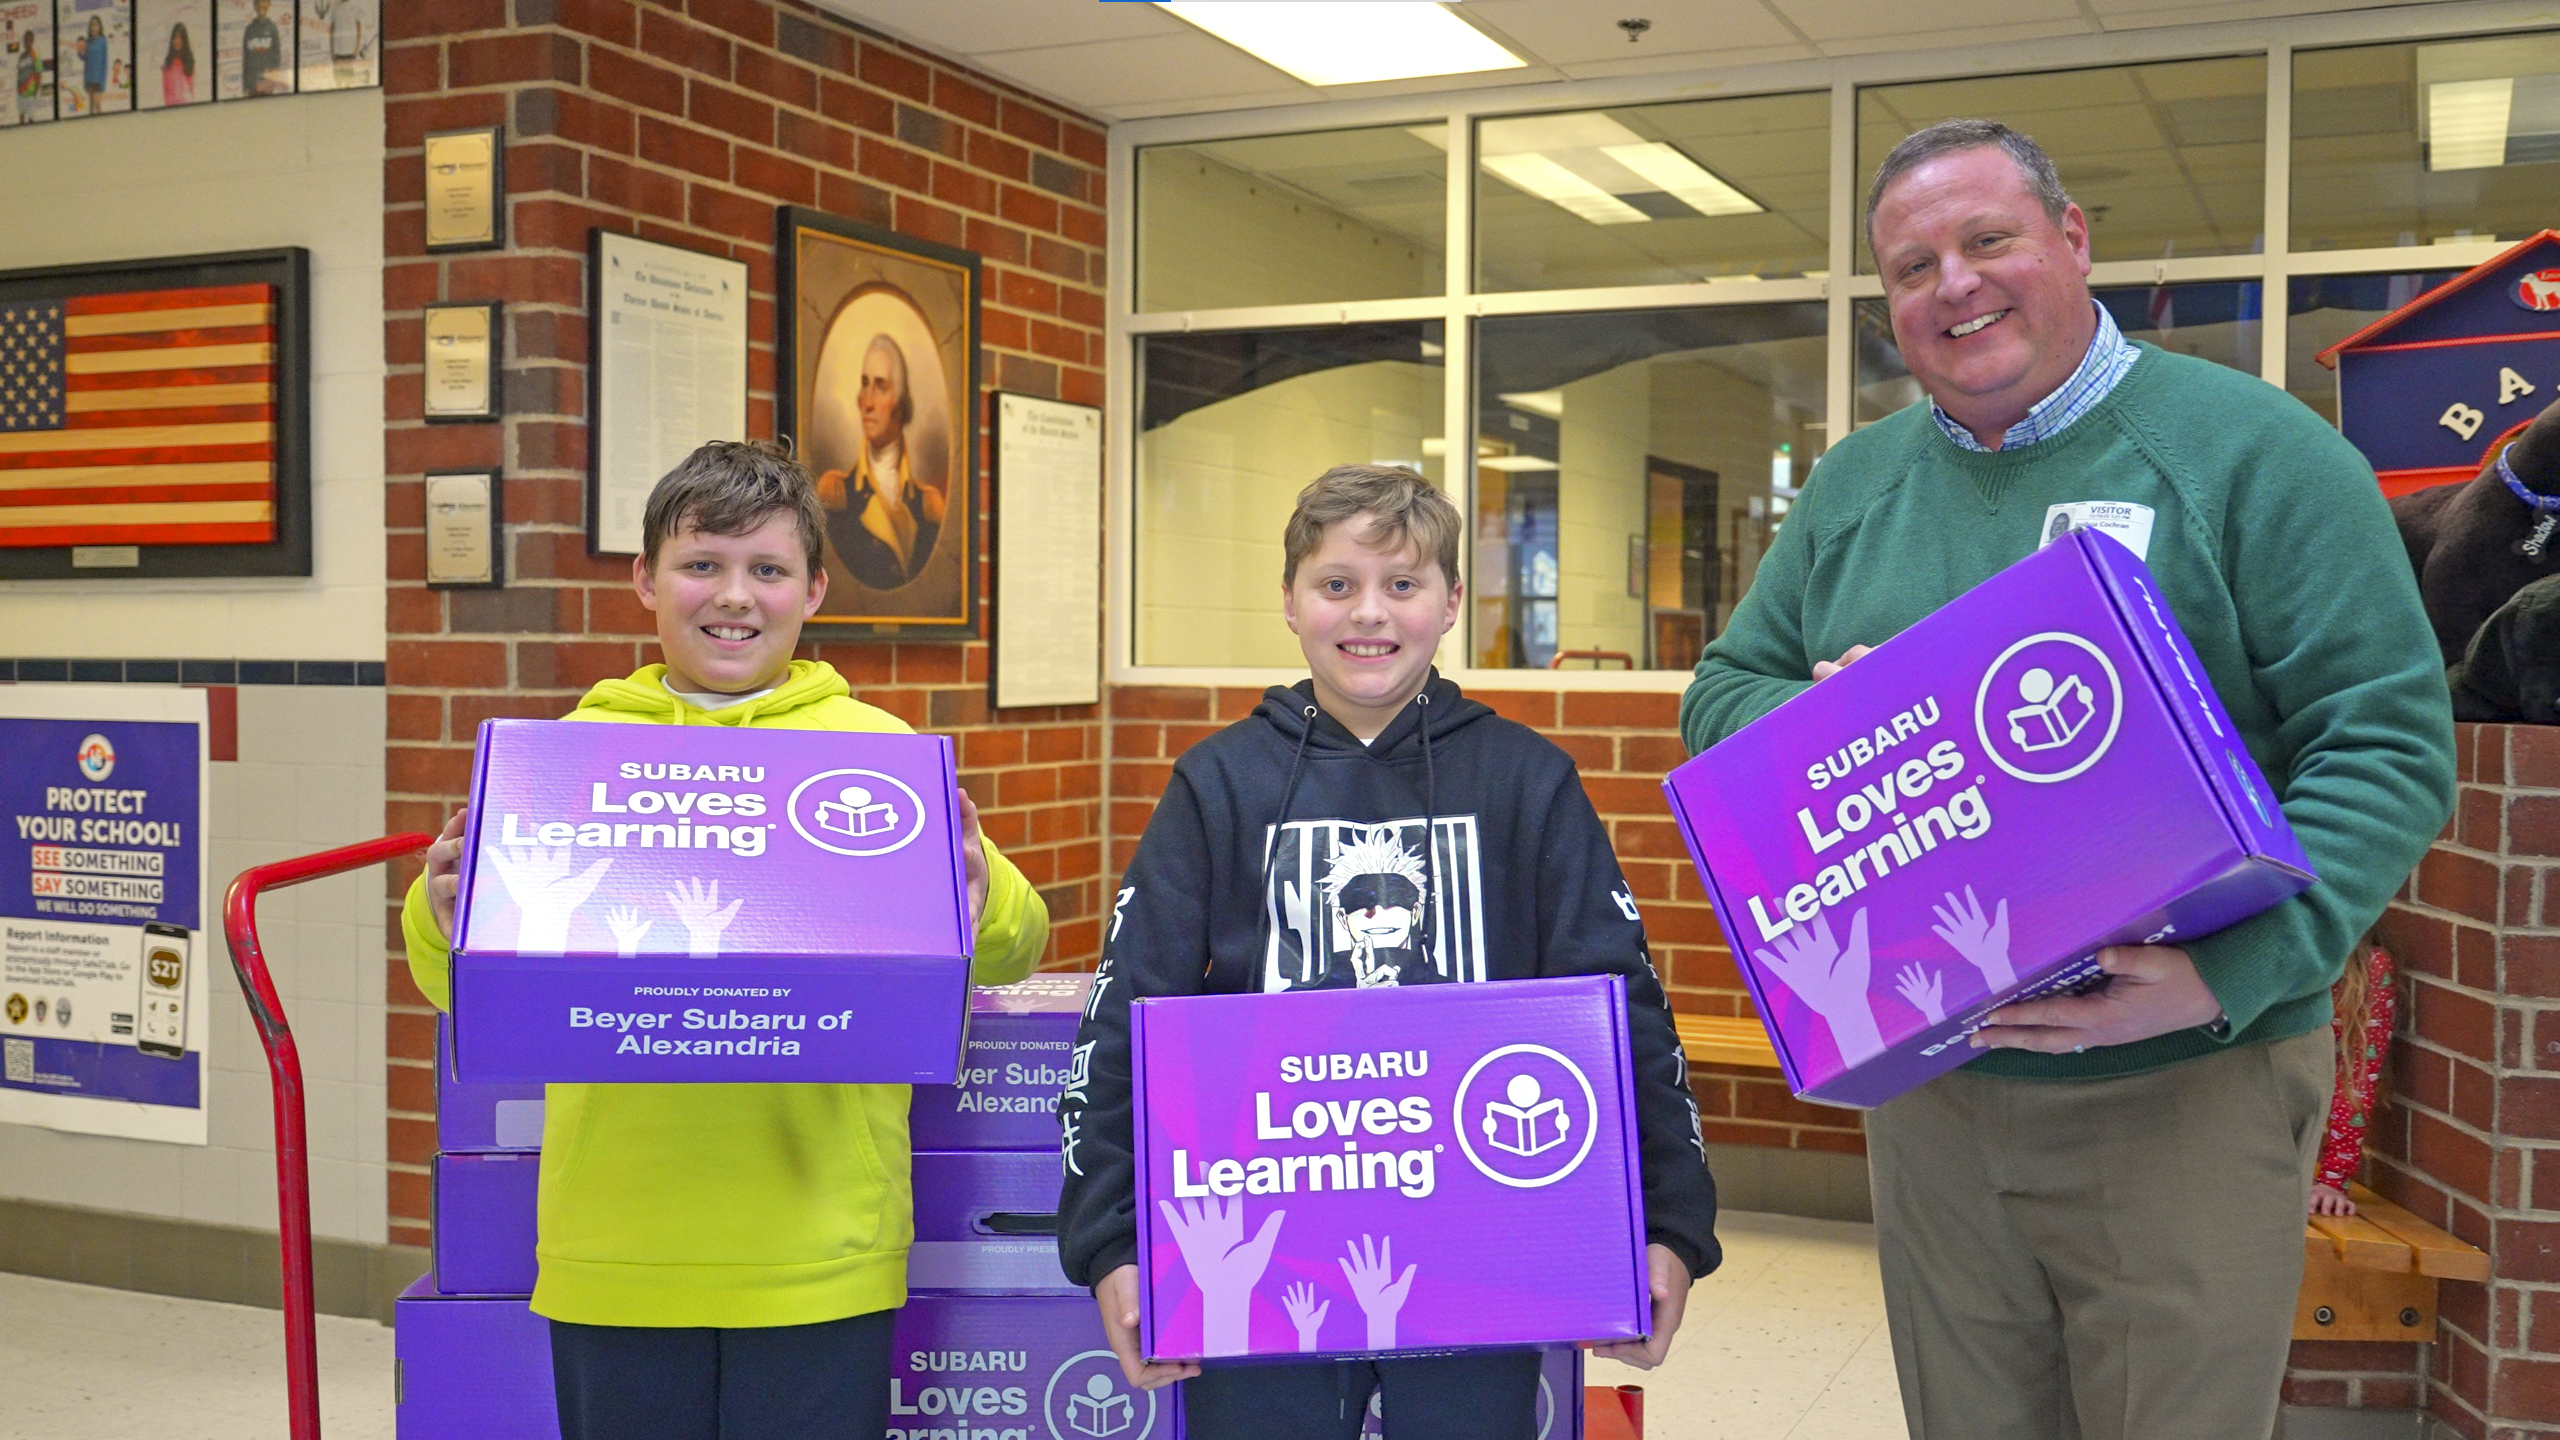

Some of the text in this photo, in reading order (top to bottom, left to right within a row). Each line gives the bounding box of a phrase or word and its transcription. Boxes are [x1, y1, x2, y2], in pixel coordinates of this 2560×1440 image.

[2091, 506, 2132, 515] VISITOR
[2100, 521, 2130, 529] Cochran
[2522, 514, 2557, 556] Shadow
[1807, 696, 1941, 790] SUBARU
[620, 762, 765, 783] SUBARU
[46, 786, 147, 815] PROTECT
[592, 782, 766, 817] Loves
[1797, 740, 1965, 855] Loves
[16, 815, 180, 847] YOUR SCHOOL!
[501, 813, 767, 857] Learning
[34, 850, 160, 872] SEE SOMETHING
[1747, 785, 1992, 942] Learning
[34, 877, 161, 900] SAY SOMETHING
[35, 900, 157, 919] WE WILL DO SOMETHING
[7, 927, 109, 945] Report Information
[151, 958, 180, 979] S2T
[634, 986, 792, 998] PROUDLY DONATED BY
[569, 1007, 853, 1033] Beyer Subaru of
[616, 1034, 801, 1056] Alexandria
[968, 1041, 1070, 1051] PROUDLY DONATED
[957, 1063, 1071, 1089] yer Suba
[1280, 1050, 1428, 1083] SUBARU
[956, 1091, 1063, 1113] Alexand
[1256, 1092, 1433, 1140] Loves
[1173, 1141, 1435, 1198] Learning
[982, 1245, 1025, 1254] PROUDLY
[910, 1351, 1027, 1372] SUBARU
[890, 1378, 1028, 1416] Loves
